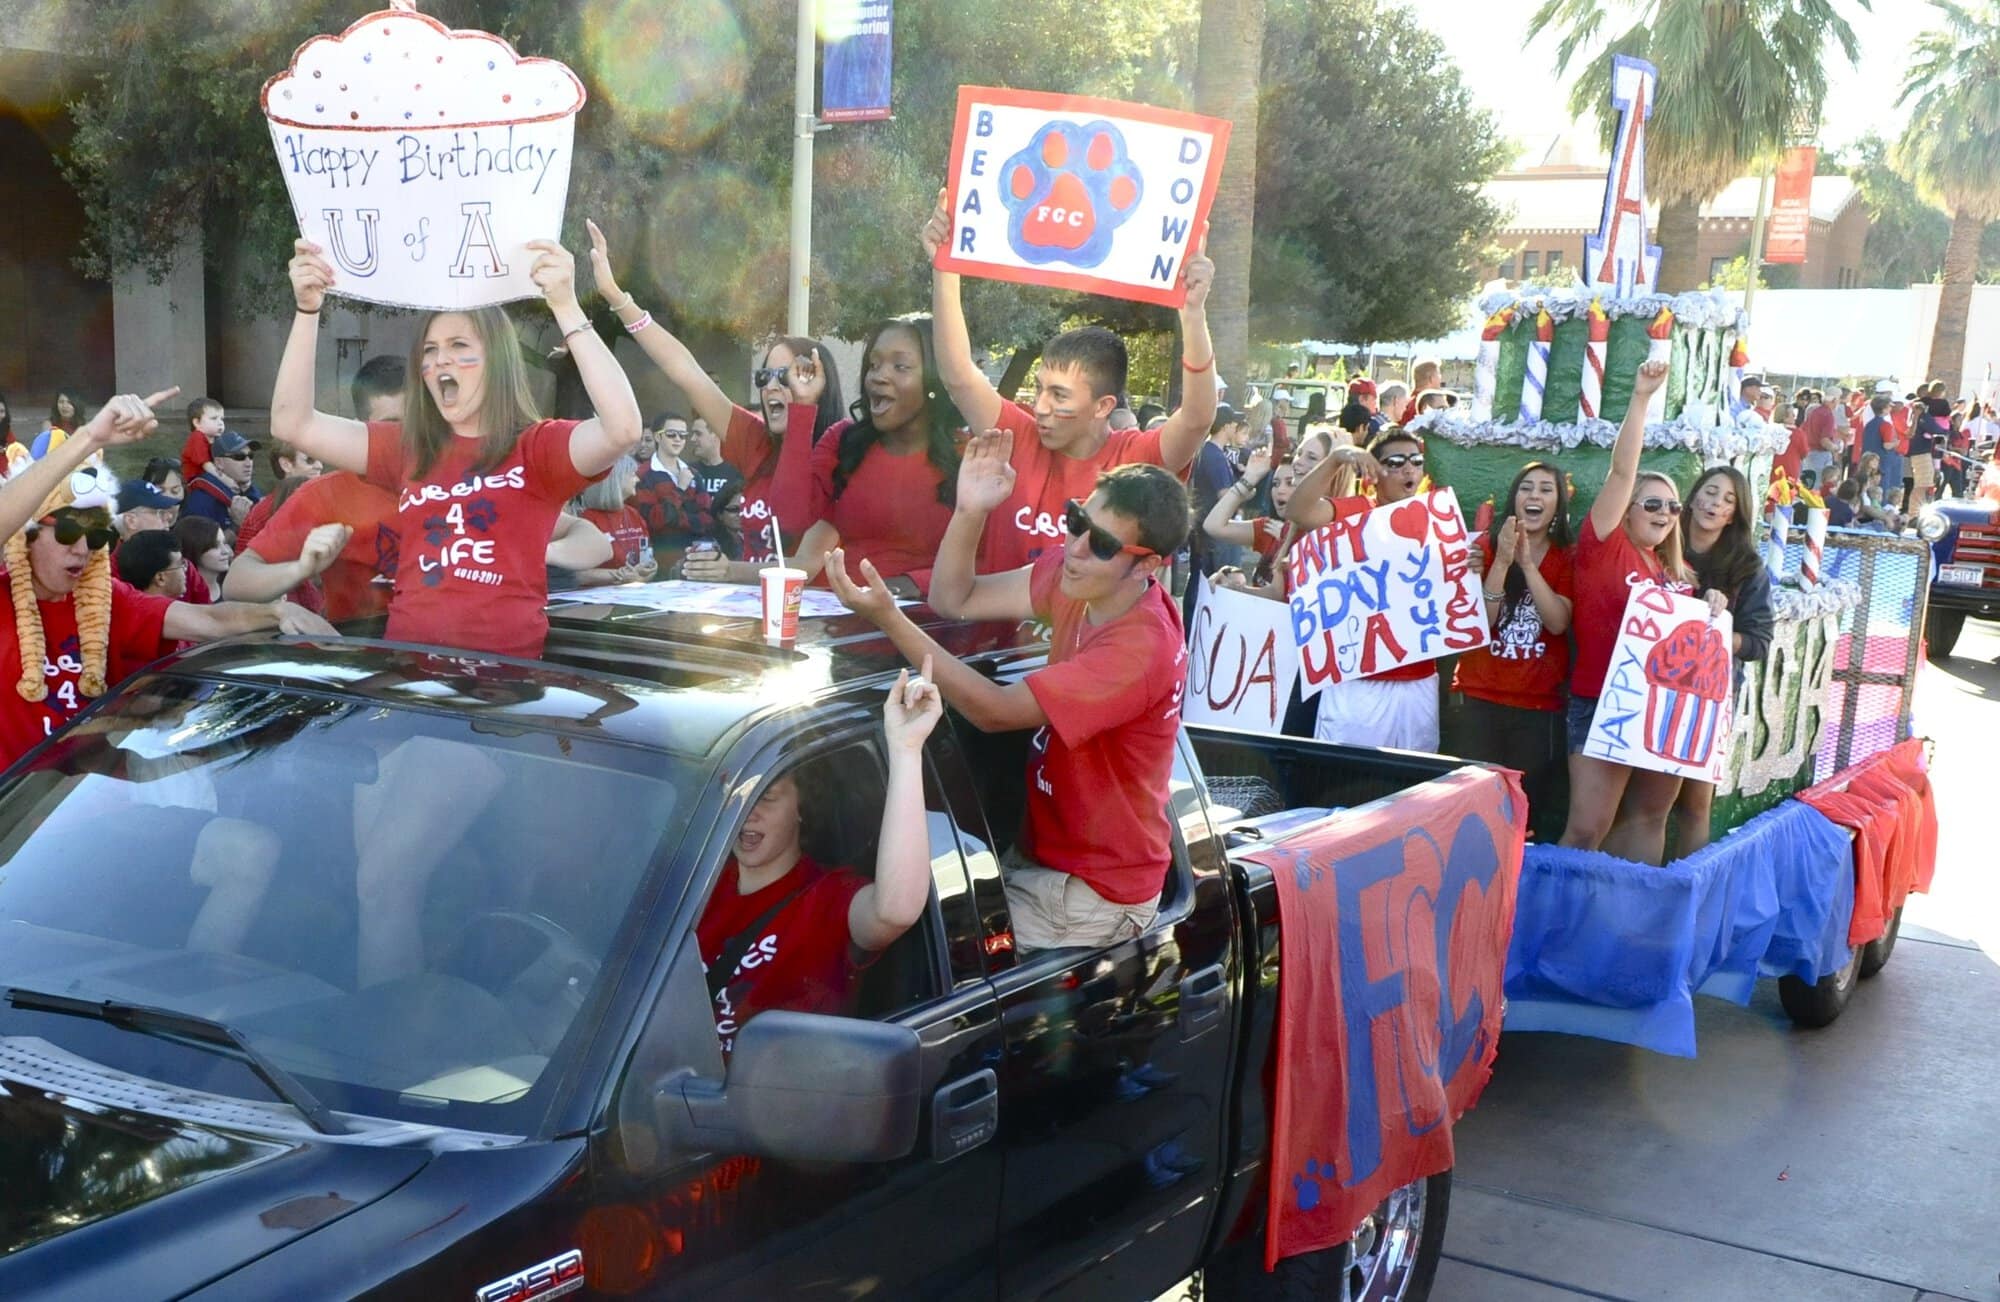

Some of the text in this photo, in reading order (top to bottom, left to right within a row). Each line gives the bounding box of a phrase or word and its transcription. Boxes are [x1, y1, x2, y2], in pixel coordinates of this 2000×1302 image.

[284, 126, 558, 195] Happy Birthday
[959, 110, 994, 254] BEAR
[322, 202, 510, 278] U of A
[1150, 136, 1202, 283] DOWN
[445, 503, 466, 535] 4
[419, 538, 496, 573] LIFE
[1302, 612, 1408, 686] U of A
[1490, 640, 1547, 660] CATS
[57, 680, 78, 709] 4
[1588, 643, 1645, 763] HAPPY
